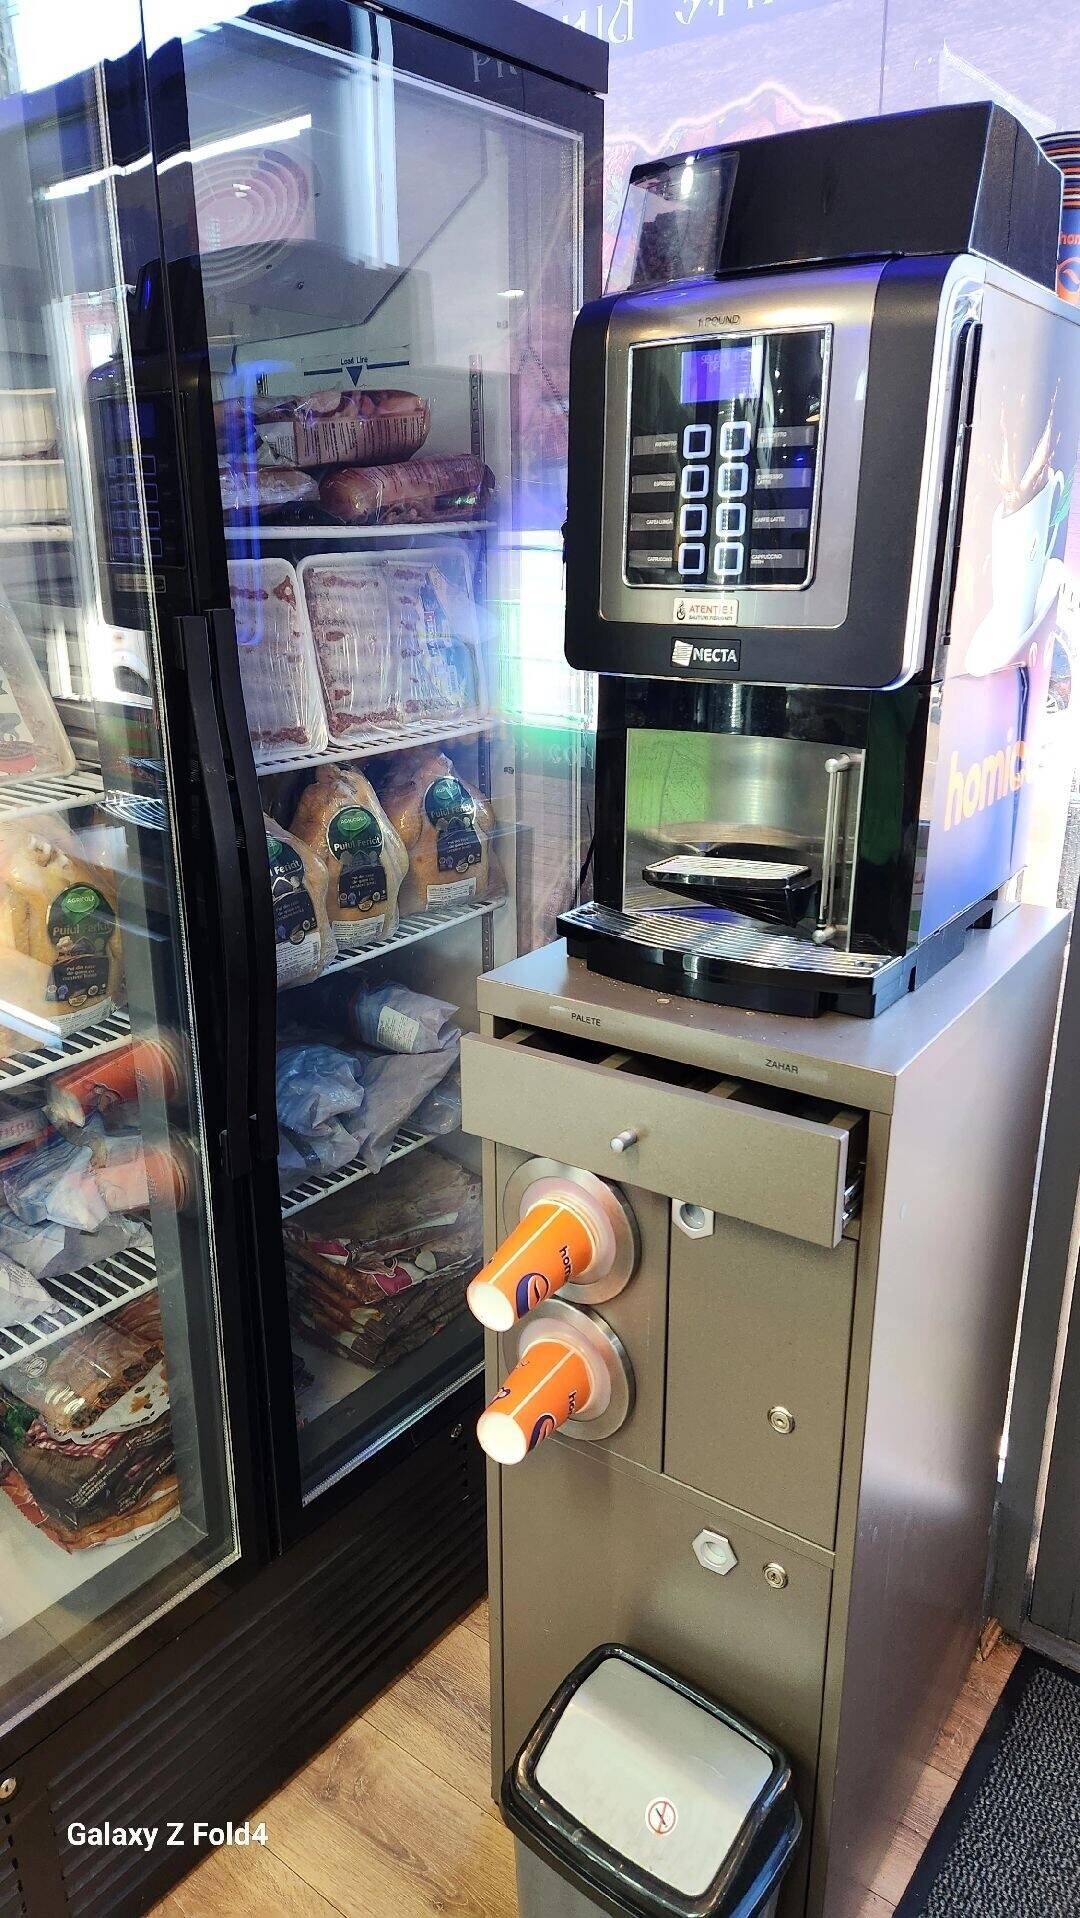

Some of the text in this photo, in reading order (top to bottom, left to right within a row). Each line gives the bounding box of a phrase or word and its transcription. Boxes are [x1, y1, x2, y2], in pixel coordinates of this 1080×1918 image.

[693, 647, 738, 662] NECTA
[274, 860, 300, 875] Fericit
[571, 1012, 601, 1027] PALETE
[765, 1058, 799, 1075] ZAHAR
